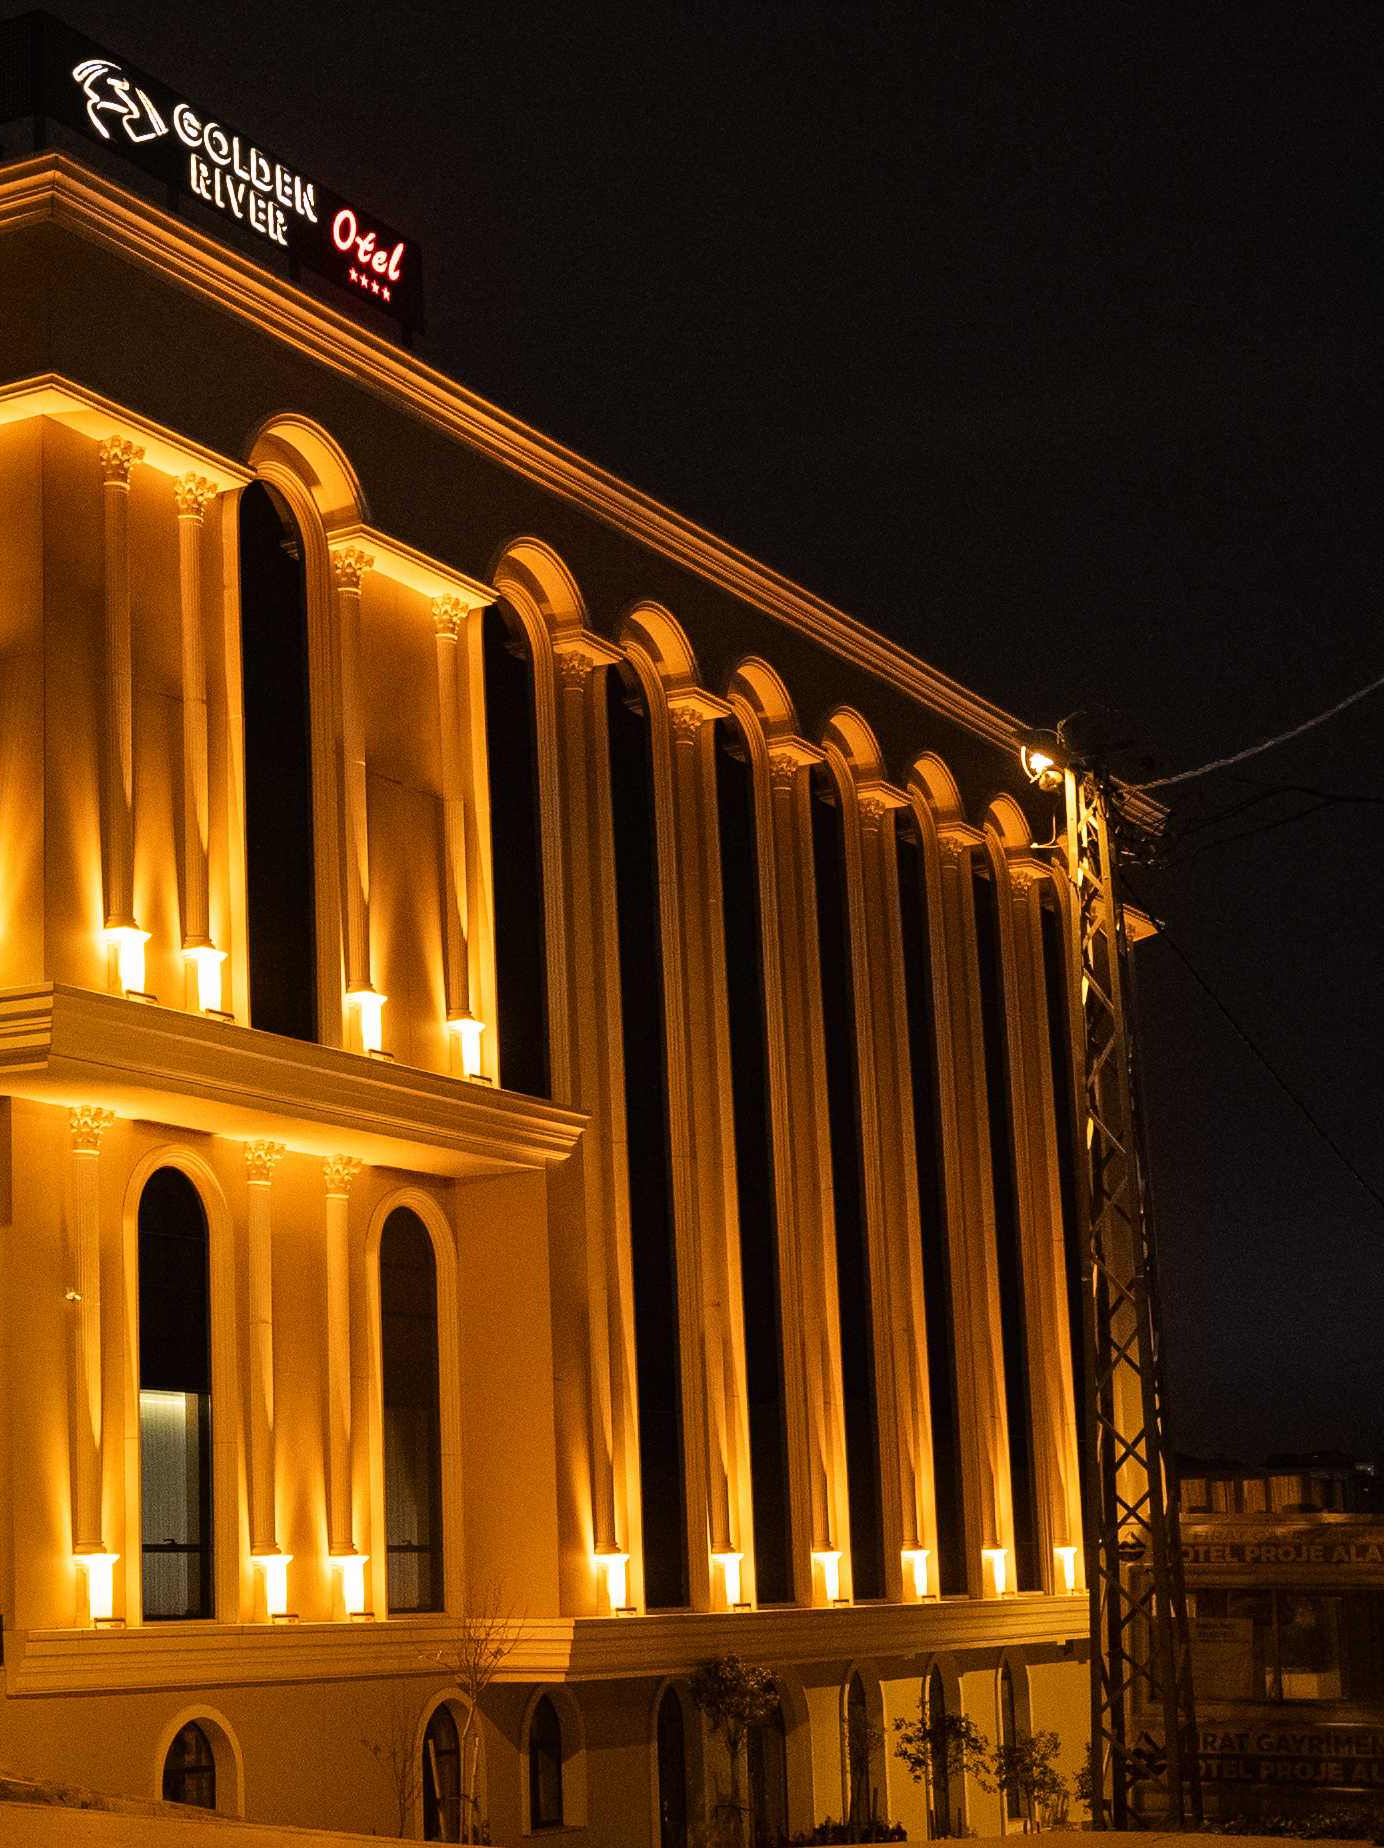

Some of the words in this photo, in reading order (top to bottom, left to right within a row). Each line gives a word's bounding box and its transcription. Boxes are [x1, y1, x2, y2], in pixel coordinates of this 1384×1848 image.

[173, 103, 318, 223] GOLDEN
[190, 153, 289, 247] RIVER
[332, 208, 405, 281] Otel
[1245, 1545, 1324, 1563] PROJE
[1260, 1760, 1344, 1781] PROJE
